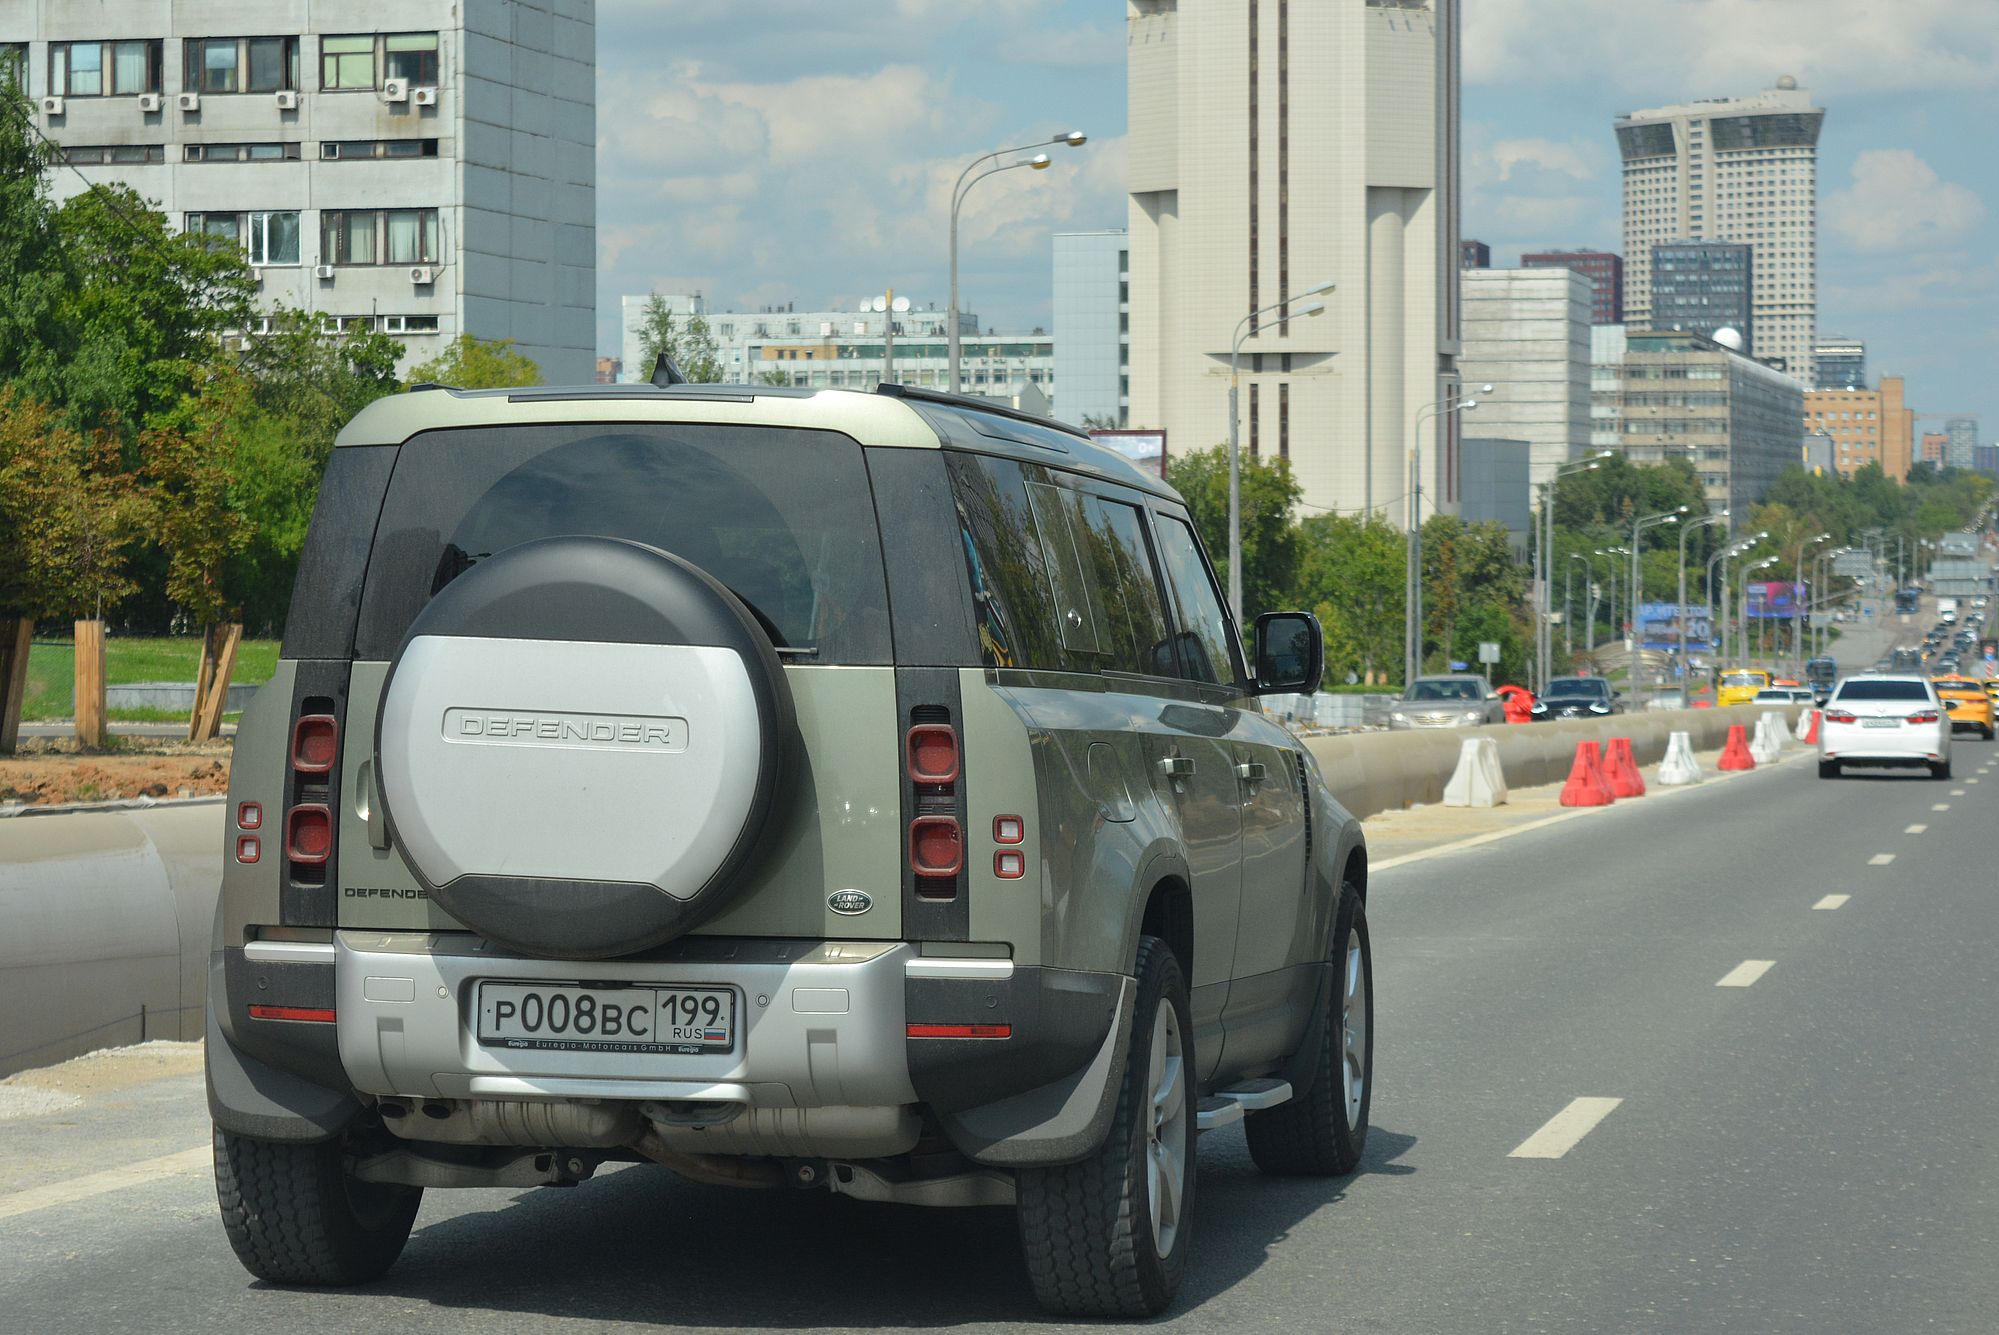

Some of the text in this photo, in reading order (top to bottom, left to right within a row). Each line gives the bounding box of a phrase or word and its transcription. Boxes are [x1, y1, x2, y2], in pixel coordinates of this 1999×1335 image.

[460, 716, 670, 743] DEFENDER
[661, 994, 720, 1027] 199
[673, 1027, 703, 1039] RUS
[640, 1044, 671, 1052] GmbH
